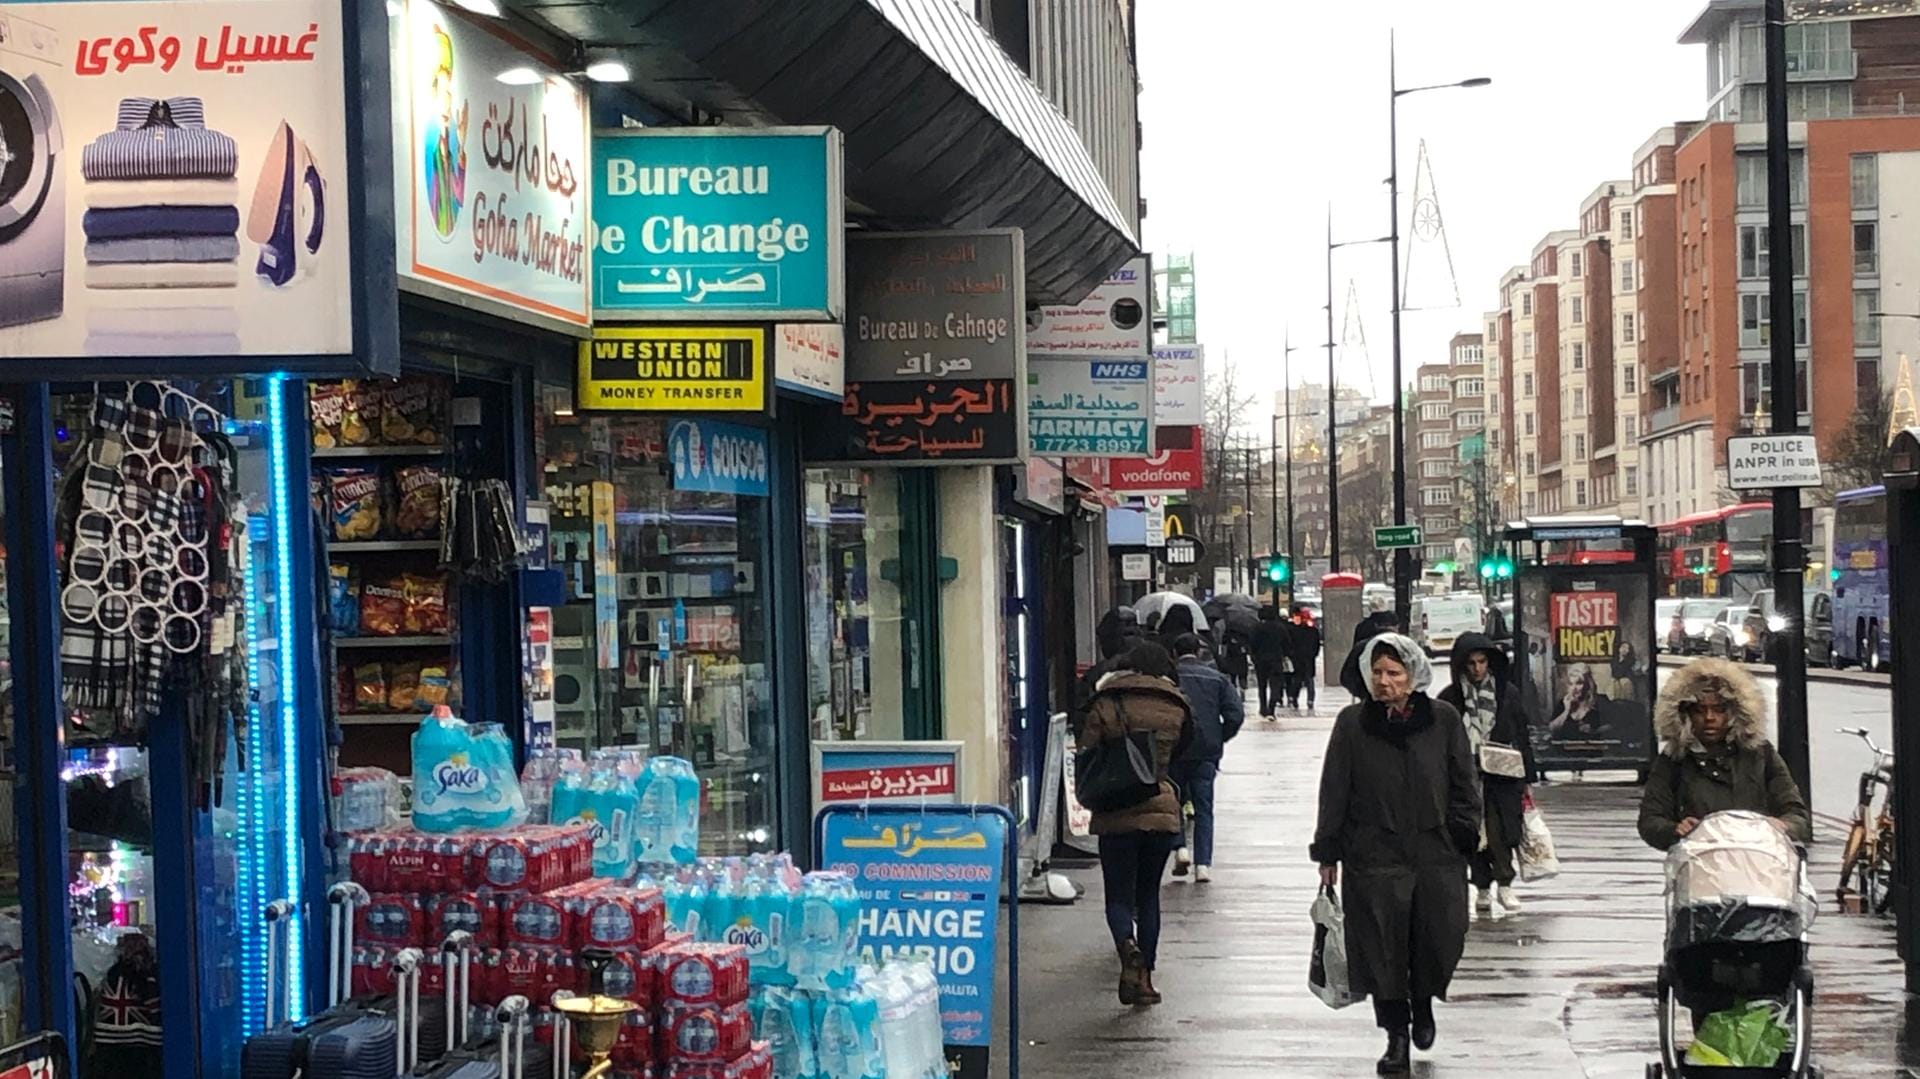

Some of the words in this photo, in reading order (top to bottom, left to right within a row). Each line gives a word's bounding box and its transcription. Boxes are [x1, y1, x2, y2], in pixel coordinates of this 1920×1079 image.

[195, 22, 318, 74] غسيل
[482, 96, 540, 193] ماركت
[543, 114, 577, 214] جحا
[607, 158, 769, 195] Bureau
[521, 212, 583, 284] Market
[642, 216, 809, 261] Change
[859, 315, 917, 340] Bureau
[945, 313, 1007, 343] Cahnge
[595, 342, 721, 359] WESTERN
[896, 350, 972, 376] صراف
[638, 361, 721, 377] UNION
[1096, 364, 1142, 377] NHS
[600, 387, 655, 399] MONEY
[664, 387, 743, 398] TRANSFER
[842, 381, 1008, 426] الجزيرة
[1076, 393, 1140, 415] صيدلية
[1029, 420, 1144, 437] HARMACY
[867, 428, 984, 457] للسياحة
[1044, 439, 1090, 452] 7723
[1096, 439, 1142, 452] 8997
[1750, 440, 1804, 454] POLICE
[1734, 456, 1777, 469] ANPR
[1782, 455, 1794, 467] in
[1798, 458, 1816, 466] use
[1121, 469, 1191, 482] vodafone
[1167, 547, 1195, 563] Hill
[1556, 596, 1614, 626] TASTE
[1560, 629, 1616, 657] HONEY
[436, 765, 480, 795] Saka
[871, 767, 948, 796] الجزيرة
[389, 855, 424, 866] ALPIN
[865, 863, 992, 882] COMMISSION
[858, 909, 985, 938] HANGE
[939, 984, 979, 996] VALUTA
